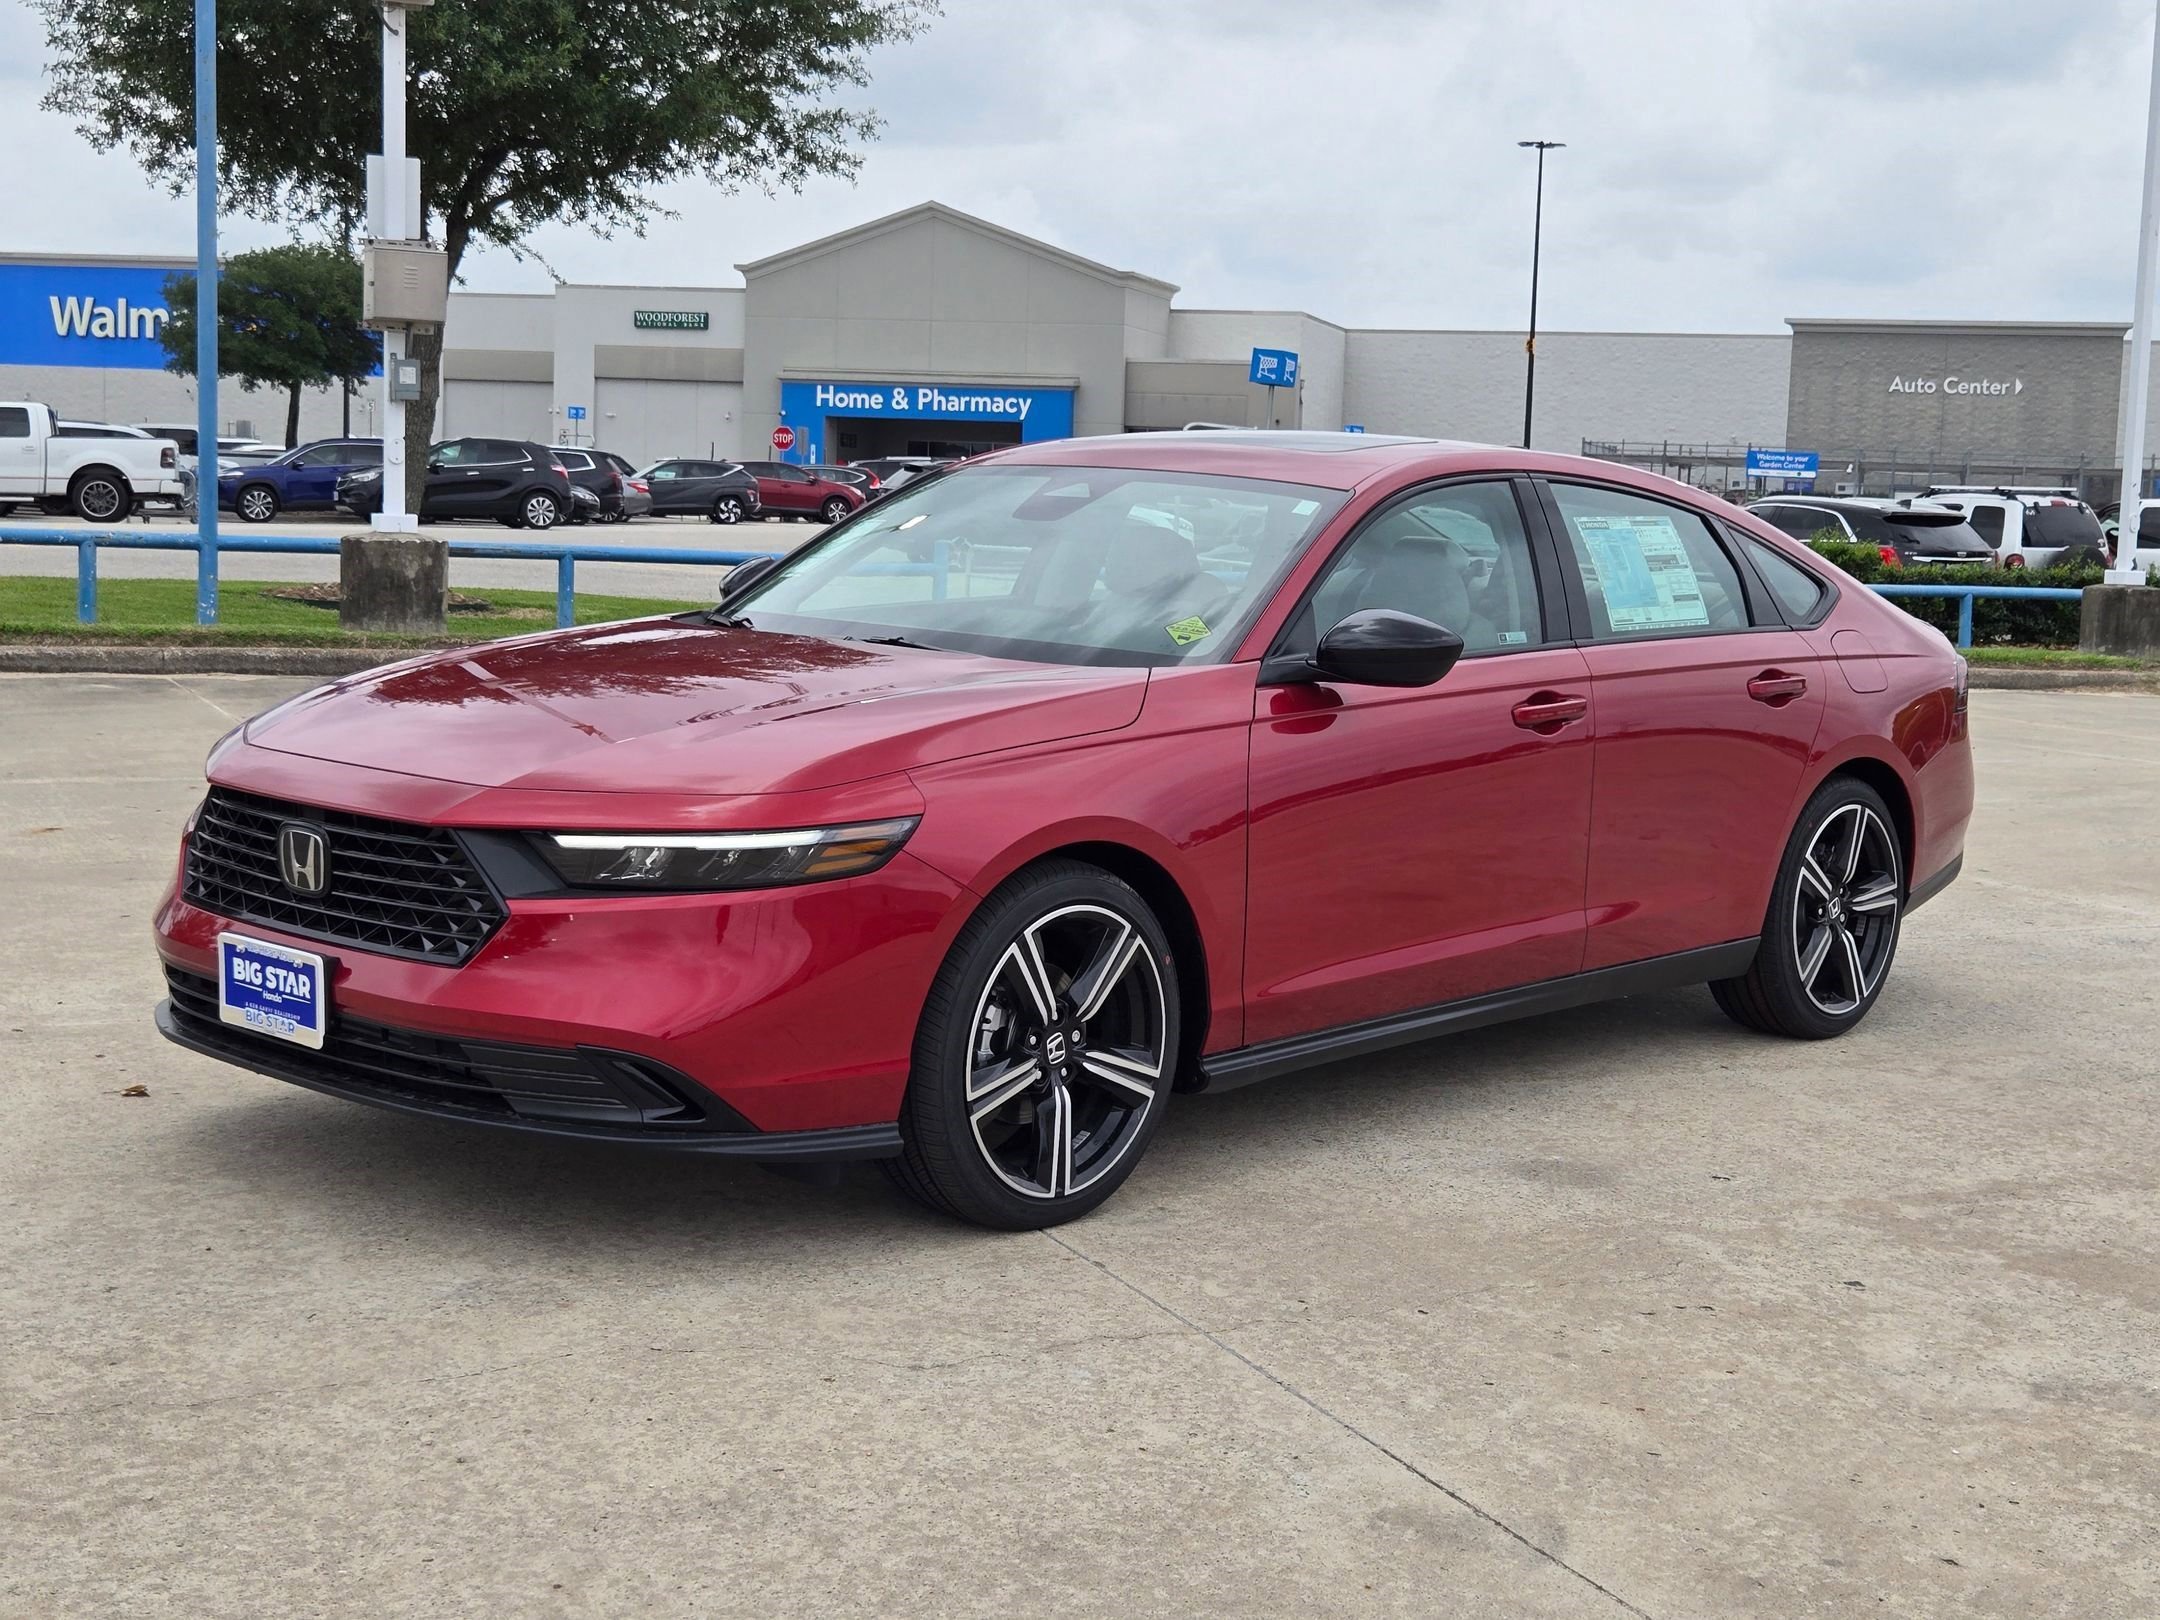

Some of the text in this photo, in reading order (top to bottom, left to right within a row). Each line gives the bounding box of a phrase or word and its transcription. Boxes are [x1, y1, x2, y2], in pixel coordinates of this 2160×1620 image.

[49, 296, 170, 339] Walm
[636, 312, 706, 322] WOODFOREST
[1888, 375, 2011, 396] Auto Center
[816, 385, 1033, 420] Home & Pharmacy
[773, 433, 793, 444] STOP
[1757, 453, 1785, 461] Welcome
[232, 957, 311, 999] BIG STAR
[262, 990, 283, 1004] Honda
[245, 1010, 295, 1033] BIG STAR
